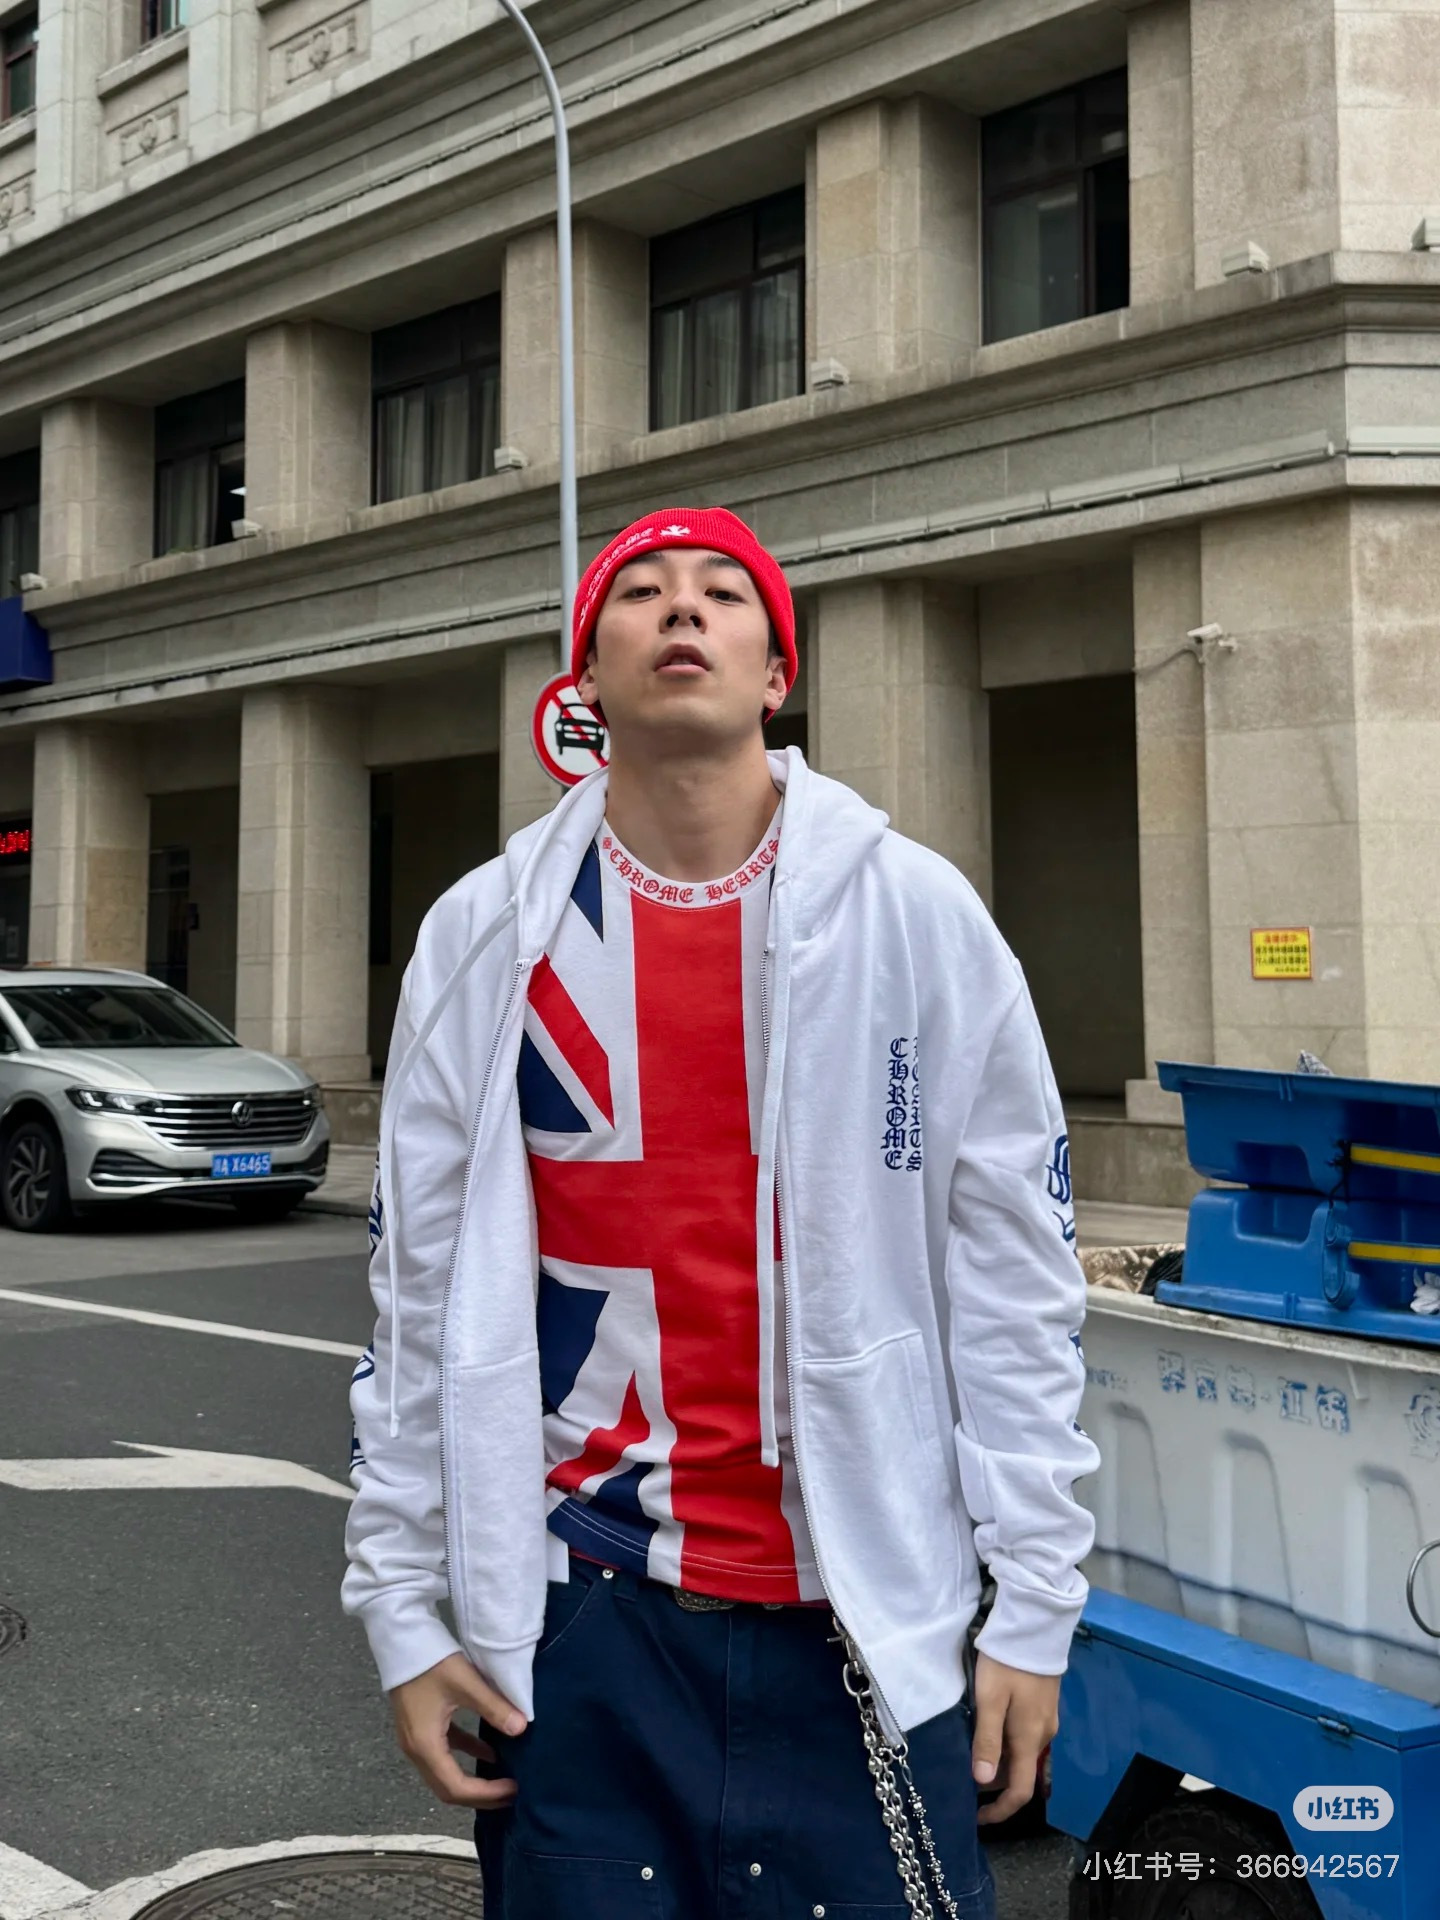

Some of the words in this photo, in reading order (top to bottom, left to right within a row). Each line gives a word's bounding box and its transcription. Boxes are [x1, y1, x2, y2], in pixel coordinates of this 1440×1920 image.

[609, 848, 694, 904] CHROME
[704, 838, 780, 903] HEARTS
[880, 1037, 909, 1171] CHROME
